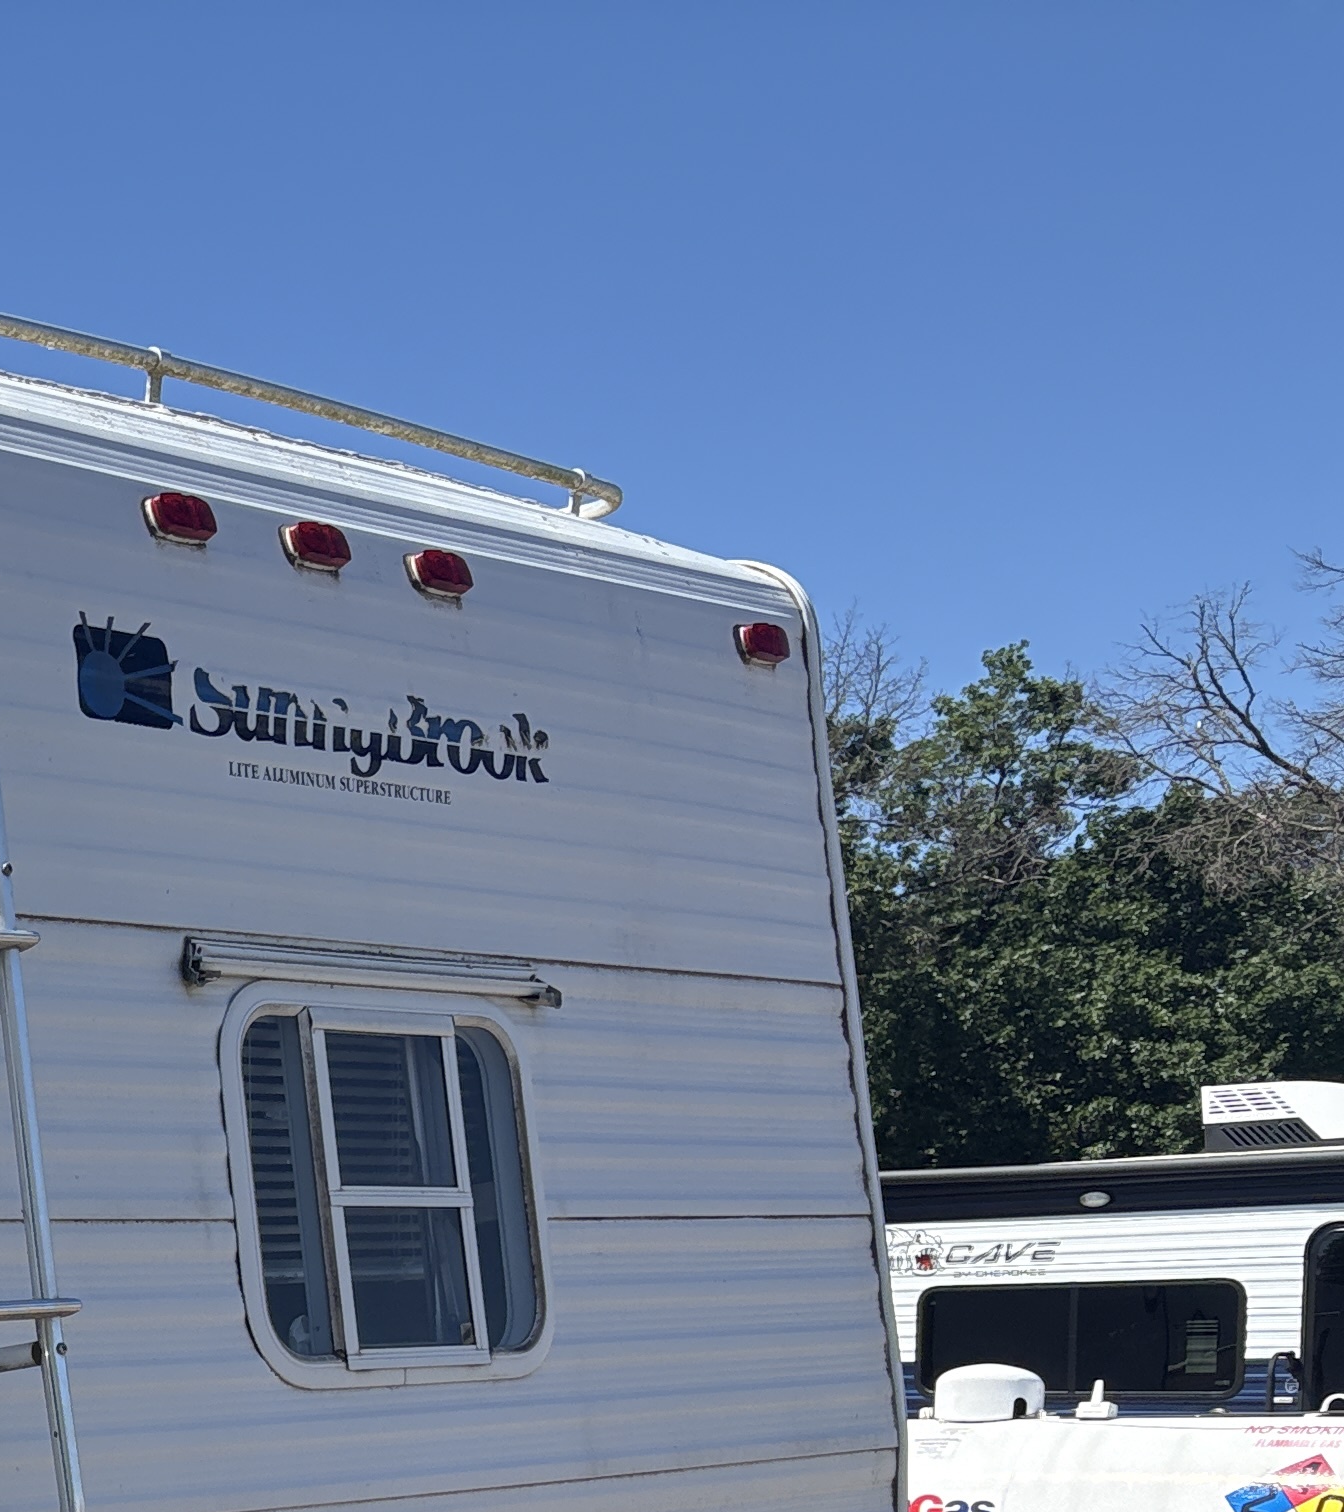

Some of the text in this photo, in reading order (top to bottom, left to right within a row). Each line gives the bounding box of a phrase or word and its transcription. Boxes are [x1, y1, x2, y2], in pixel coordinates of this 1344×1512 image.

[229, 761, 451, 805] LITE ALUMINUM SUPERSTRUCTURE
[946, 1242, 1061, 1264] CAVE
